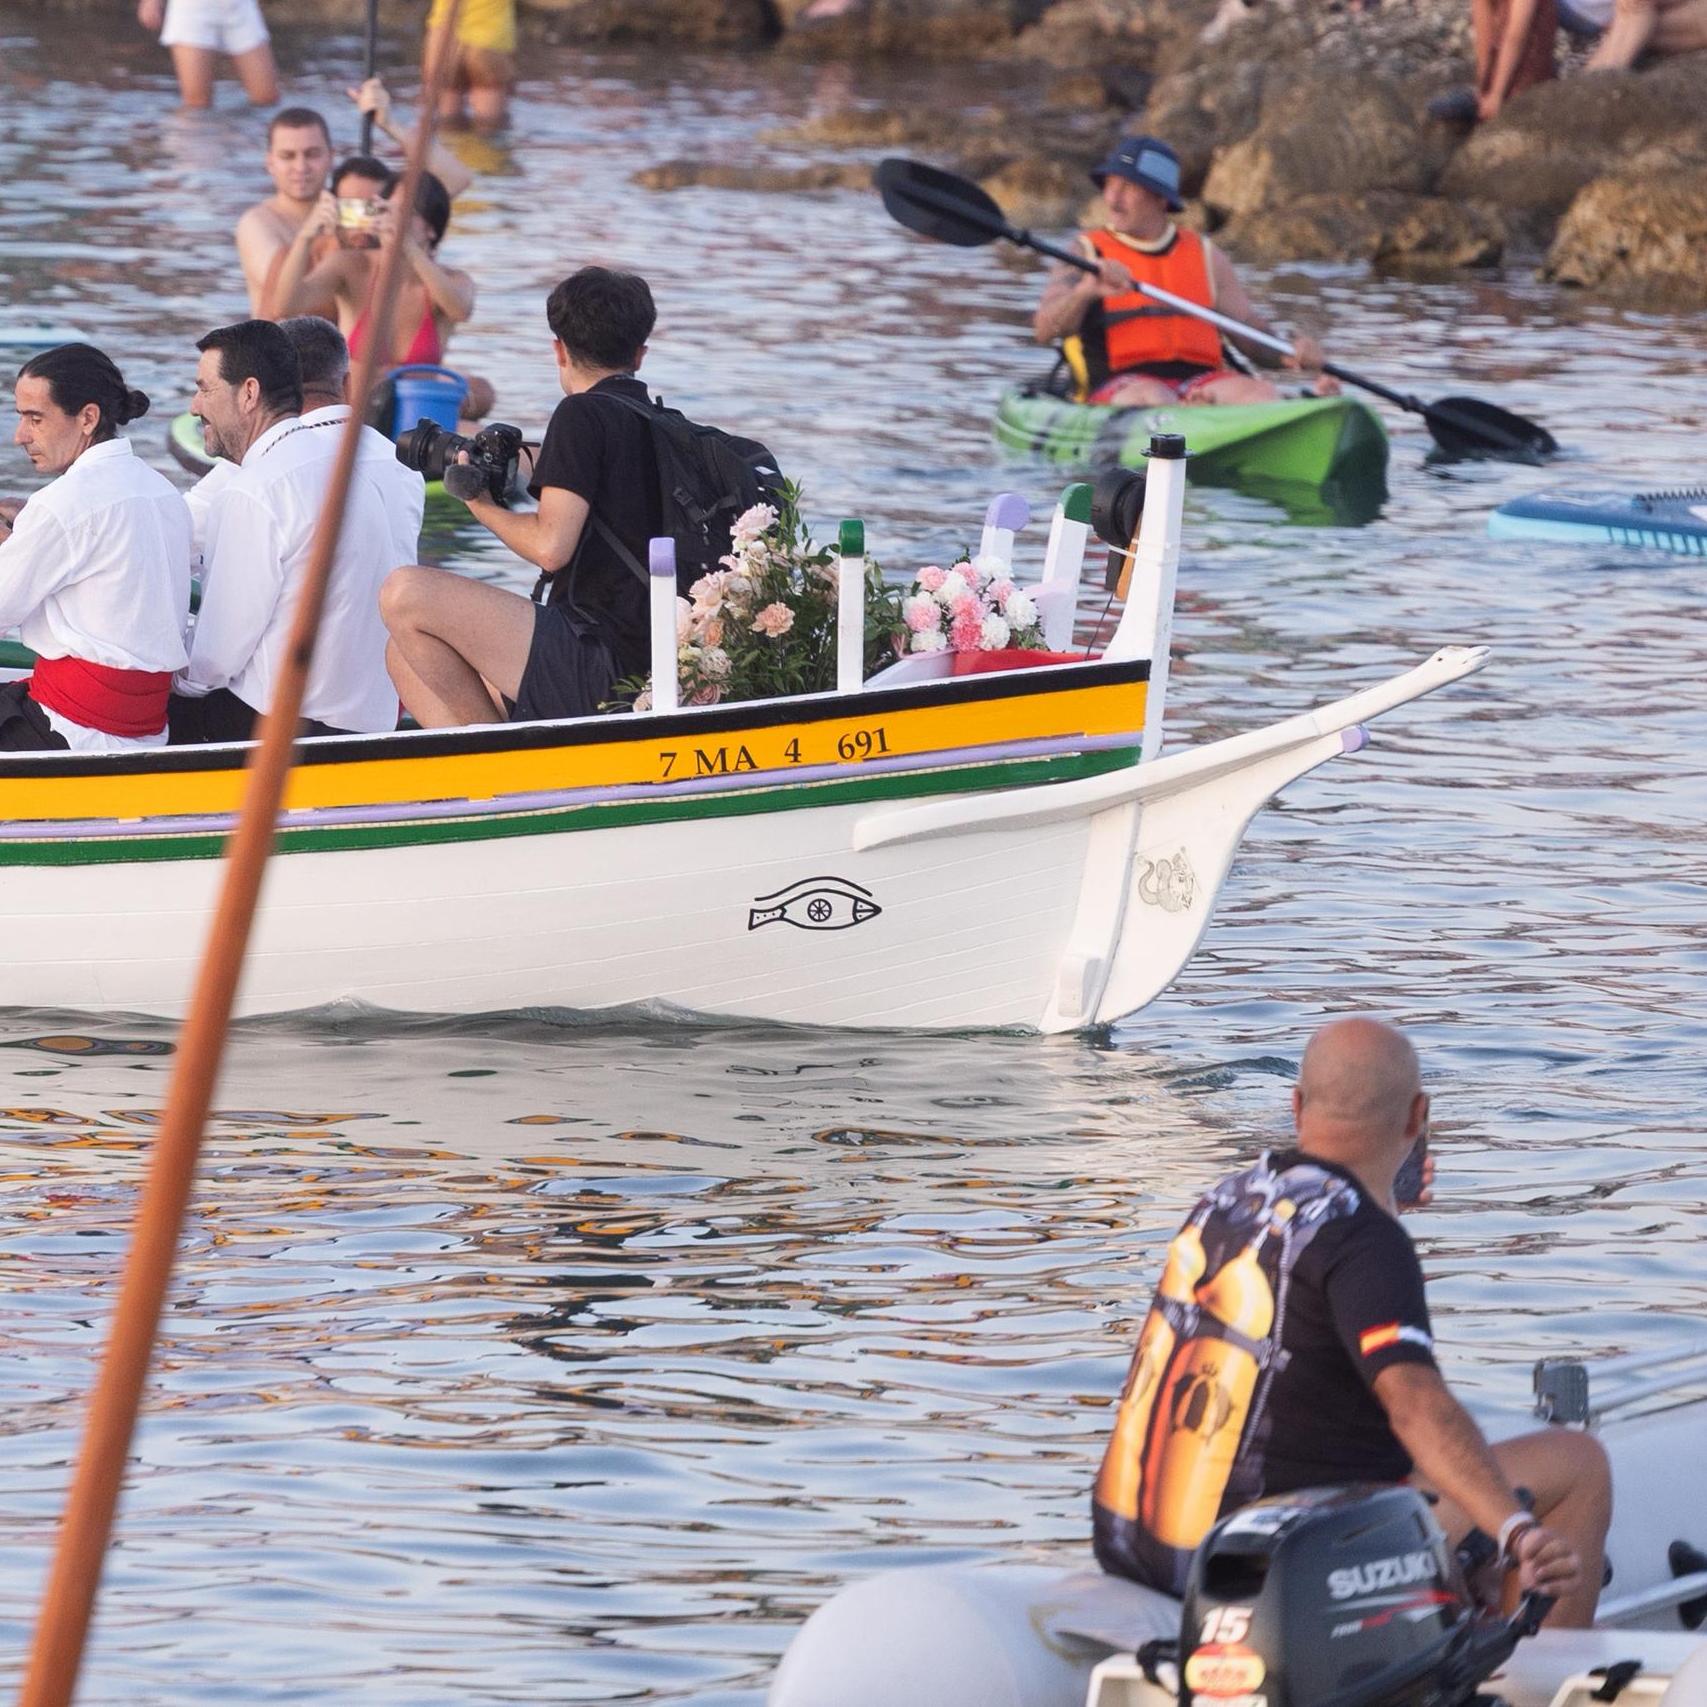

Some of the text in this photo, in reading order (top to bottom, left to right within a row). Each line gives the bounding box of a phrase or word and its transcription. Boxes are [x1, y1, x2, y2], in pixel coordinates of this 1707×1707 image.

[659, 727, 892, 778] 7 MA 4 691
[1326, 1550, 1437, 1600] SUZUKI
[1199, 1606, 1254, 1644] 15
